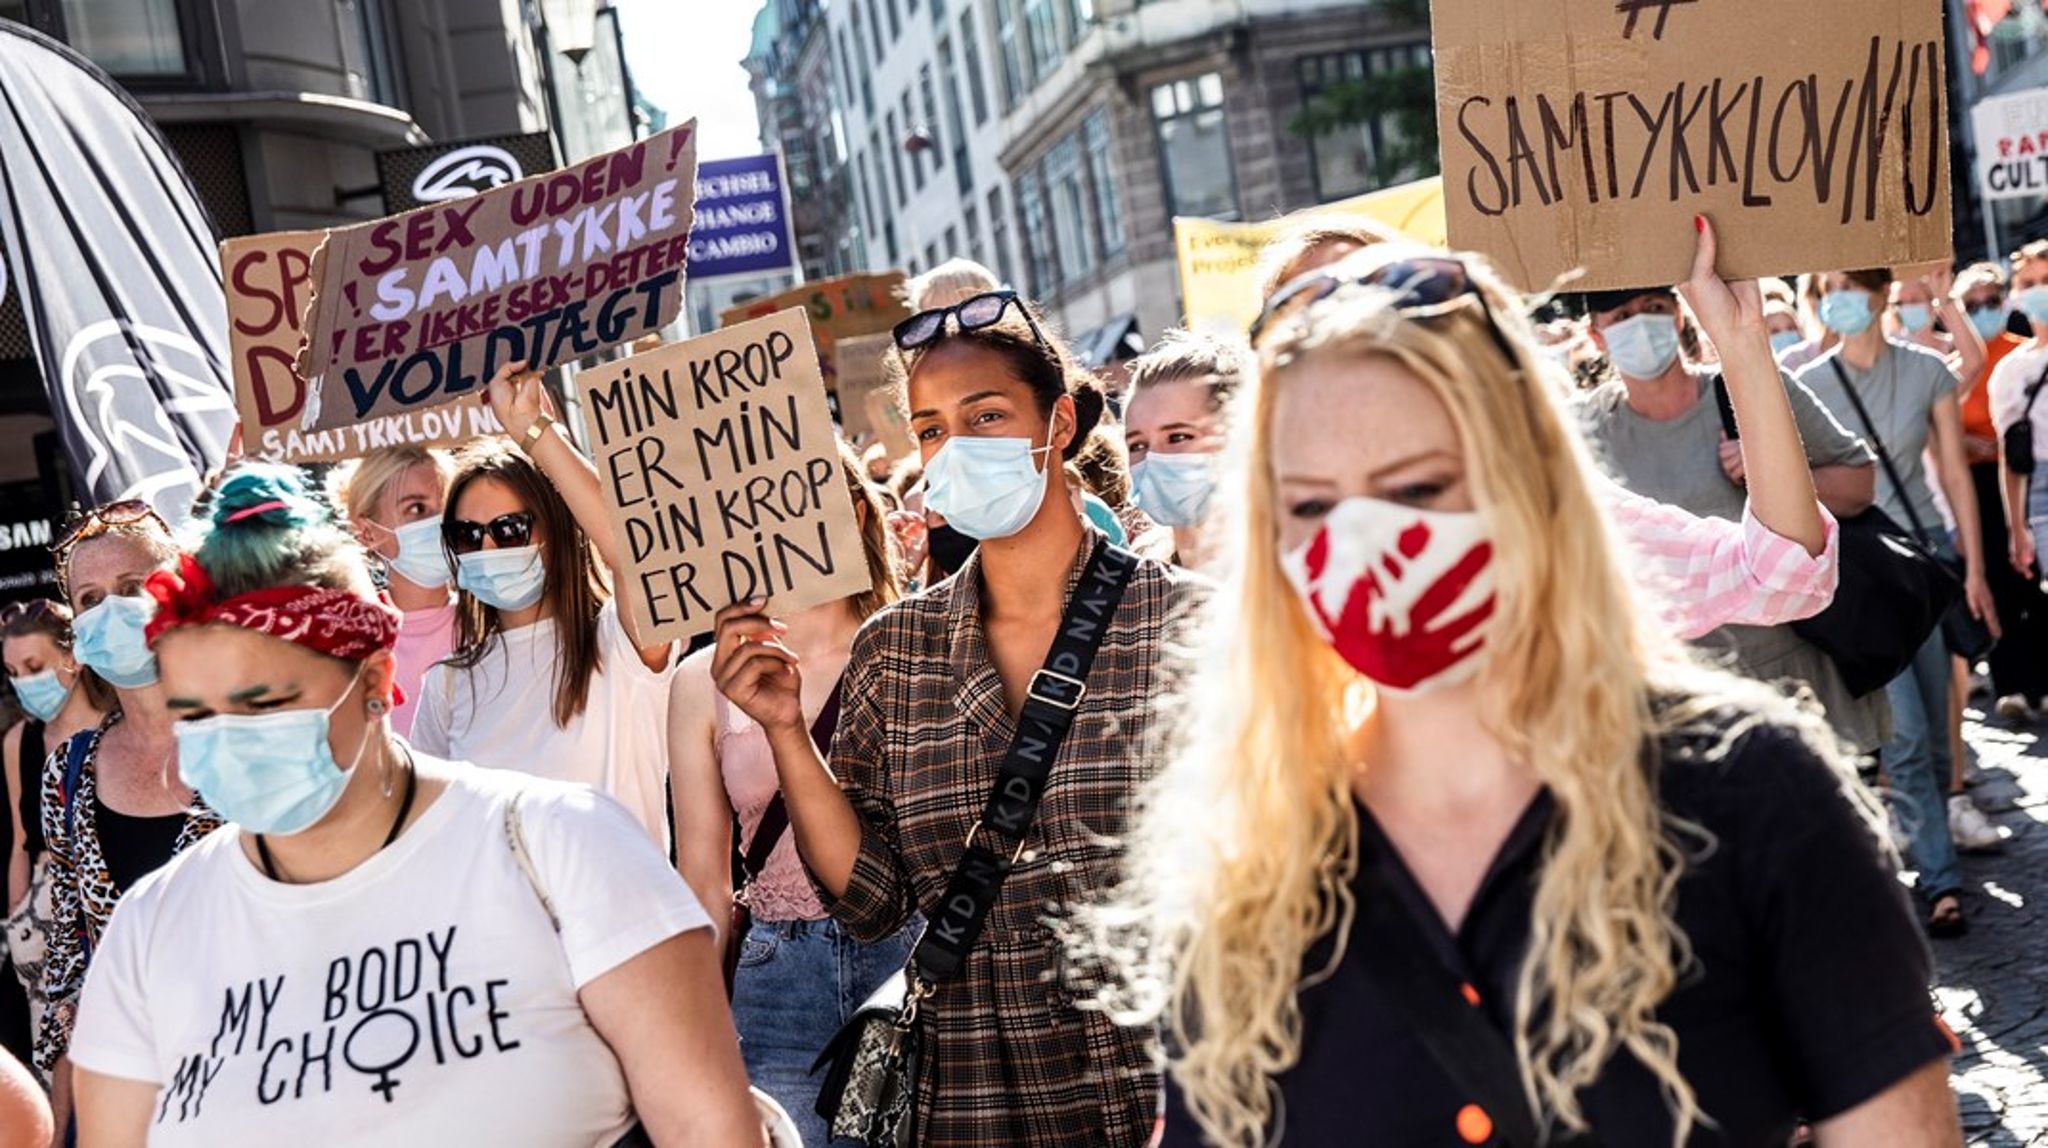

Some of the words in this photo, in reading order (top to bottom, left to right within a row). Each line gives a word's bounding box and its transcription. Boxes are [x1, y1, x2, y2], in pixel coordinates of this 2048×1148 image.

[359, 199, 484, 276] SEX
[510, 143, 647, 226] UDEN
[665, 128, 692, 171] !
[696, 201, 777, 231] HANGE
[369, 179, 678, 321] SAMTYKKE
[689, 231, 778, 262] CAMBIO
[343, 269, 680, 418] VOLDTÆGT
[354, 322, 412, 363] ER
[417, 294, 501, 348] IKKE
[688, 330, 794, 410] KROP
[608, 436, 684, 508] ER
[716, 458, 833, 539] KROP
[640, 562, 713, 627] ER
[211, 974, 285, 1058] MY
[323, 925, 457, 1023] BODY
[157, 1053, 225, 1124] MY
